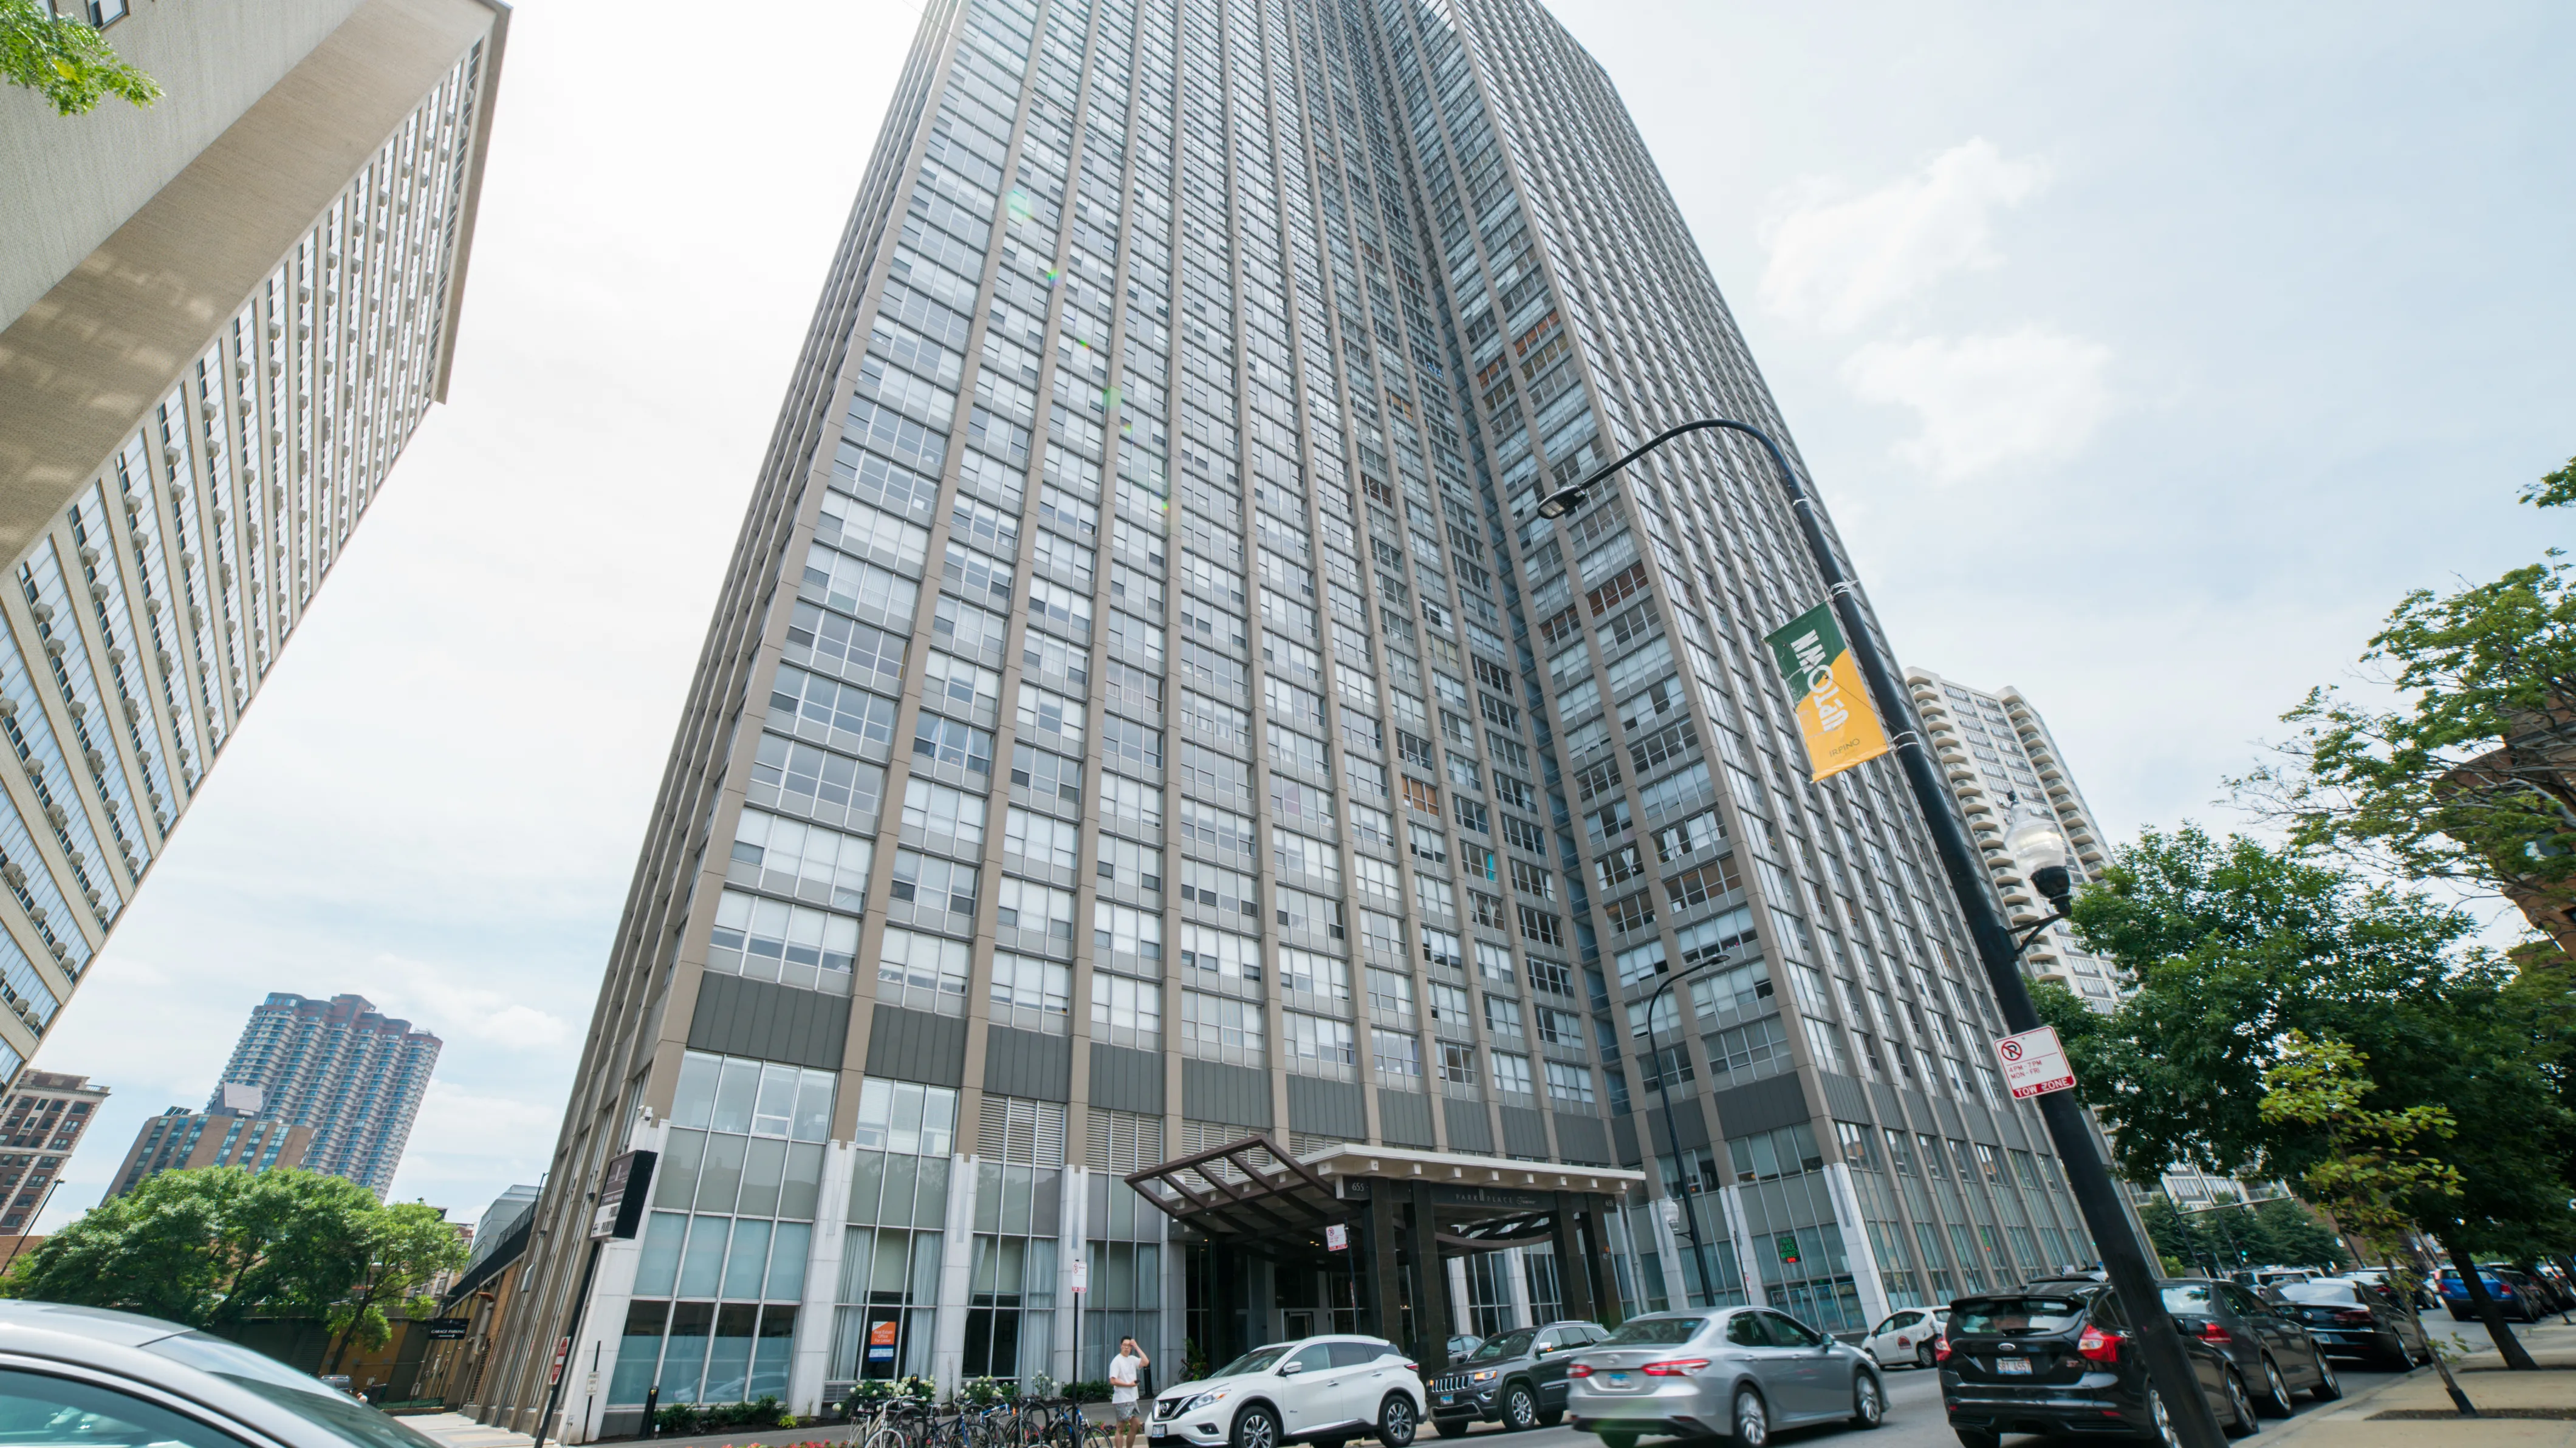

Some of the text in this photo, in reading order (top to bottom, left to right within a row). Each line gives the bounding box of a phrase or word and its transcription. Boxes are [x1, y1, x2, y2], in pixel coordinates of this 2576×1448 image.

[1790, 629, 1849, 732] UPTOWN
[1829, 738, 1860, 757] IRPINO
[2016, 1077, 2070, 1097] TOW ZONE
[1352, 1183, 1364, 1191] 655
